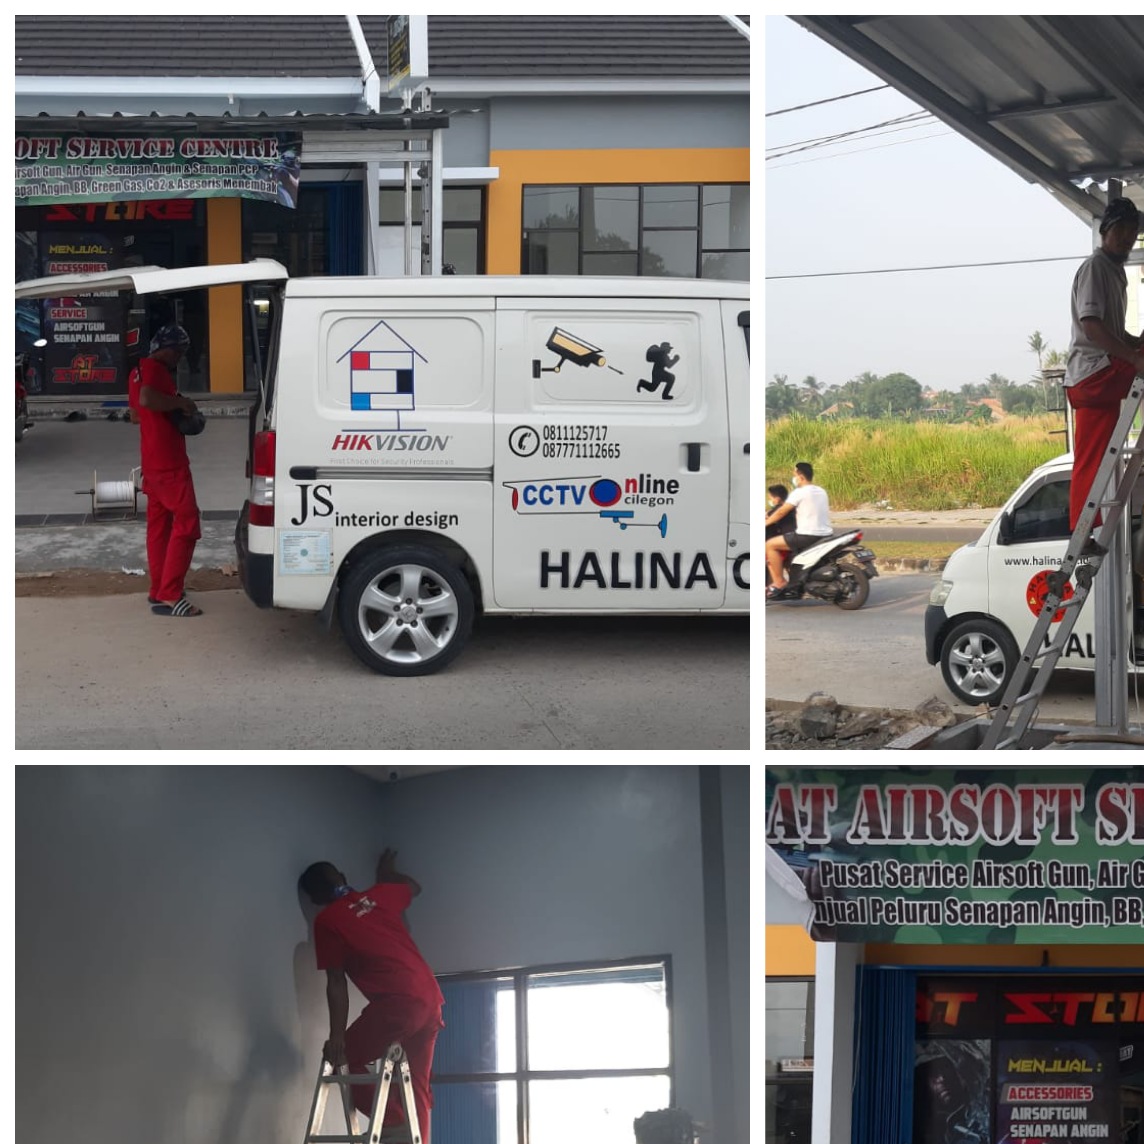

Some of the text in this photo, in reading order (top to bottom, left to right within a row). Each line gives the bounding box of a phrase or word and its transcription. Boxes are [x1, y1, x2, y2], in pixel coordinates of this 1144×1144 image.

[66, 137, 174, 159] SERVICE
[180, 137, 278, 159] CENTRE
[66, 164, 81, 177] Air
[106, 163, 150, 177] Senapan
[152, 163, 182, 176] Angin
[184, 164, 192, 174] &
[193, 162, 237, 176] Senapan
[239, 164, 259, 175] PCP
[91, 179, 121, 193] Green
[123, 178, 144, 193] Gas,
[146, 178, 166, 191] Co2
[168, 181, 175, 190] &
[177, 178, 221, 191] Asesoris
[223, 178, 278, 195] Menembak
[51, 263, 107, 272] ACCESSORIES
[52, 309, 86, 318] SERVICE
[54, 323, 105, 331] AIRSOFTGUN
[54, 333, 120, 343] SENAPAN ANGIN
[543, 425, 607, 441] 0811125717
[331, 434, 450, 451] HIKVISION
[542, 443, 620, 459] 087771112665
[522, 485, 587, 505] CCTV
[624, 495, 674, 507] cilegon
[291, 484, 334, 526] JS
[335, 511, 459, 529] interior design
[540, 551, 718, 590] HALINA
[766, 784, 838, 845] AT
[847, 784, 1084, 846] AIRSOFT
[820, 859, 883, 888] Pusat
[884, 859, 969, 888] Service
[972, 859, 1044, 888] Airsoft
[1047, 860, 1094, 890] Gun,
[1097, 859, 1129, 888] Air
[871, 898, 942, 925] Peluru
[945, 897, 1041, 928] Senapan
[1043, 897, 1111, 928] Angin,
[1008, 1058, 1093, 1074] MENJUAL
[1008, 1086, 1094, 1101] ACCESSORIES
[1011, 1107, 1087, 1120] AIRSOFTGUN
[1010, 1124, 1108, 1138] SENAPAN ANGIN
